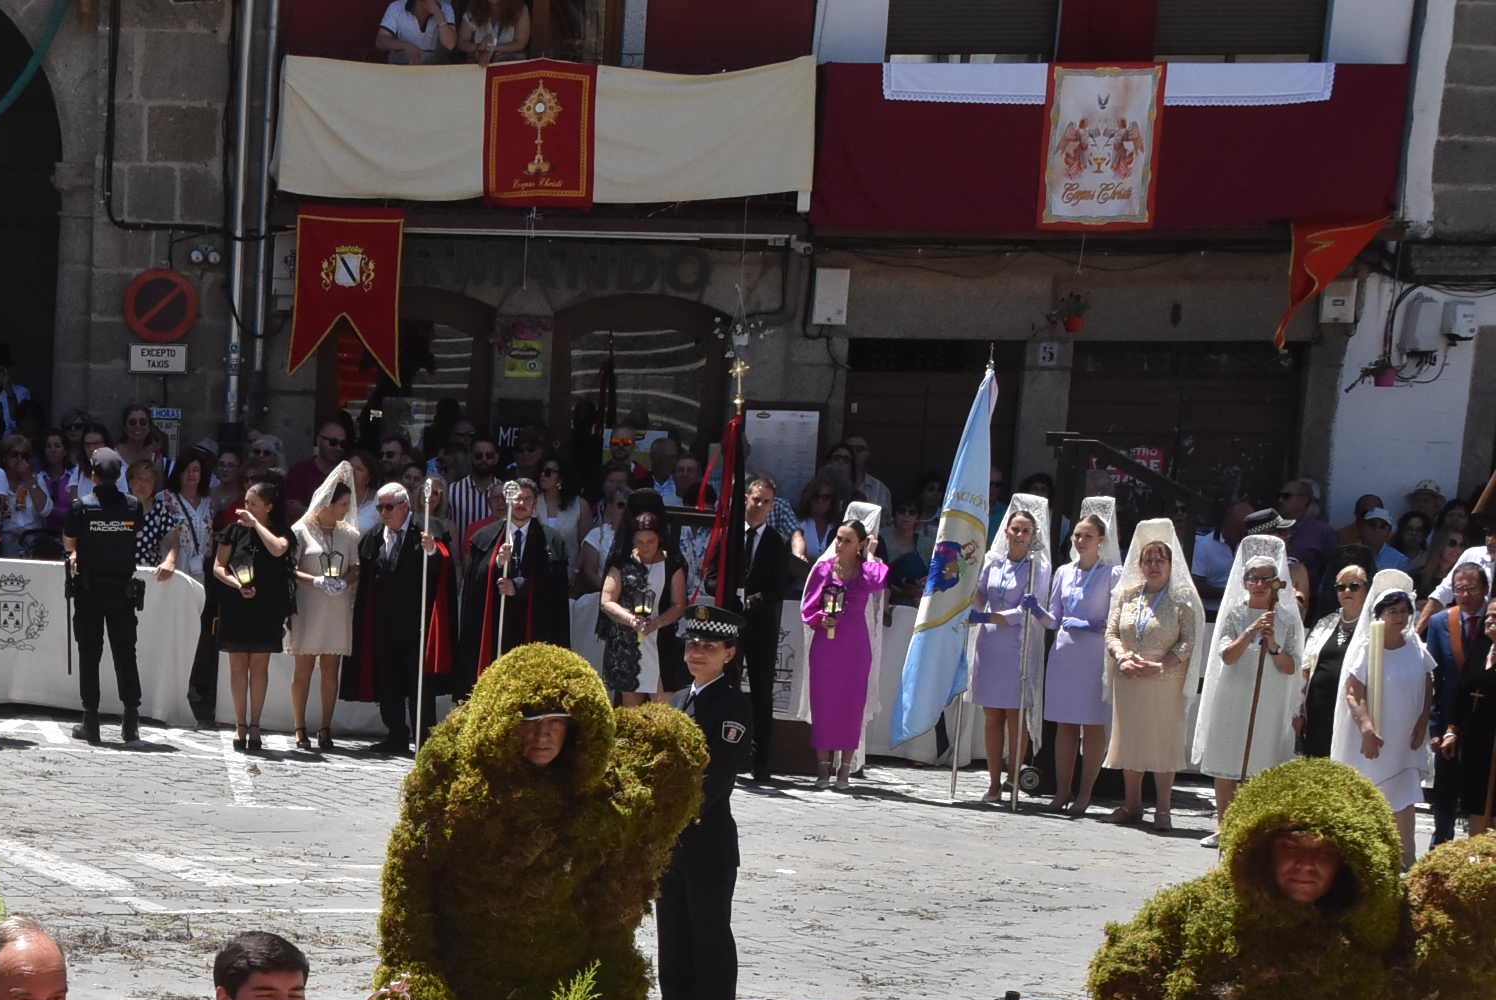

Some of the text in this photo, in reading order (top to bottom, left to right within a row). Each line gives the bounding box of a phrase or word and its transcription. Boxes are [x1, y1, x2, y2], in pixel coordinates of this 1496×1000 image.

[141, 348, 176, 358] EXCEPTO
[1042, 343, 1055, 363] 5
[147, 359, 169, 369] TAXIS
